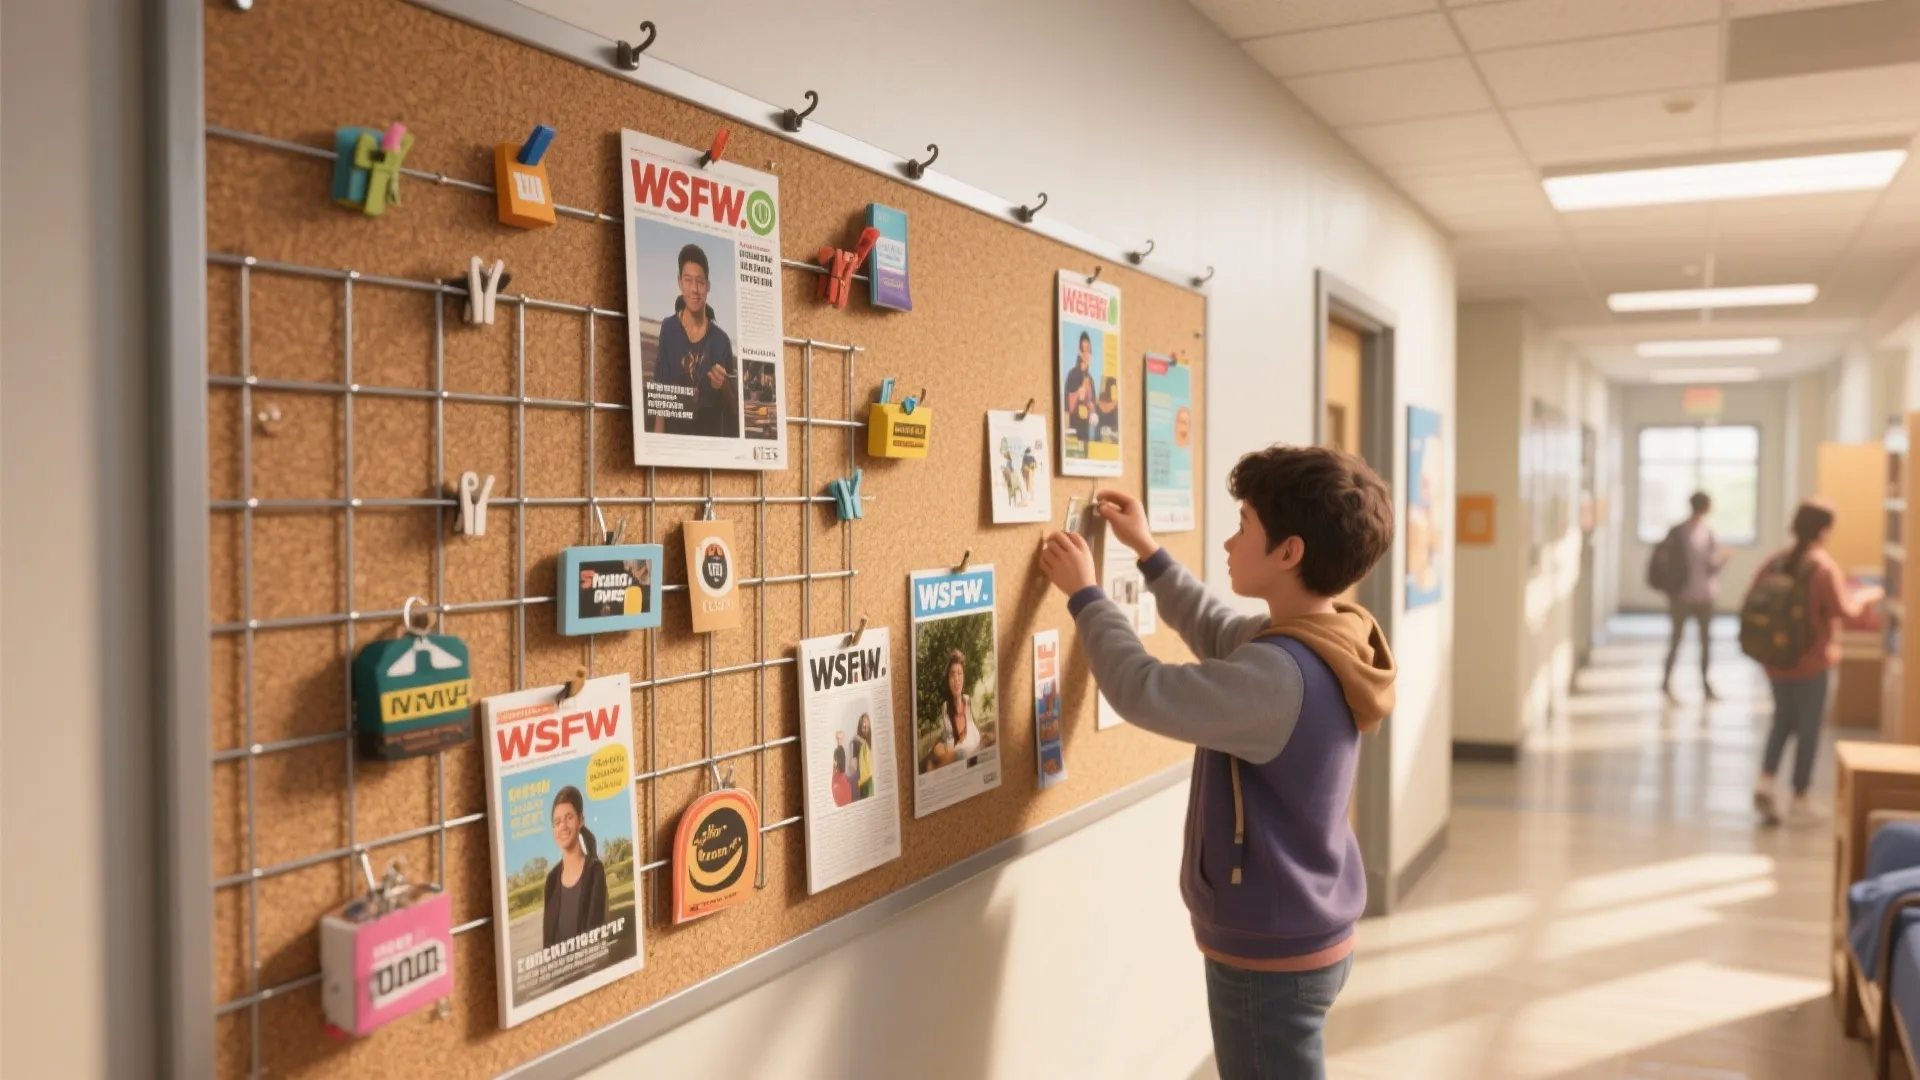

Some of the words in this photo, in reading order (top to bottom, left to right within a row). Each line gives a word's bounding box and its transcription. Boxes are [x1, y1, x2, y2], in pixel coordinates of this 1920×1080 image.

[631, 158, 747, 230] WSFW.
[918, 578, 989, 611] WSFW.
[497, 704, 620, 763] WSFW
